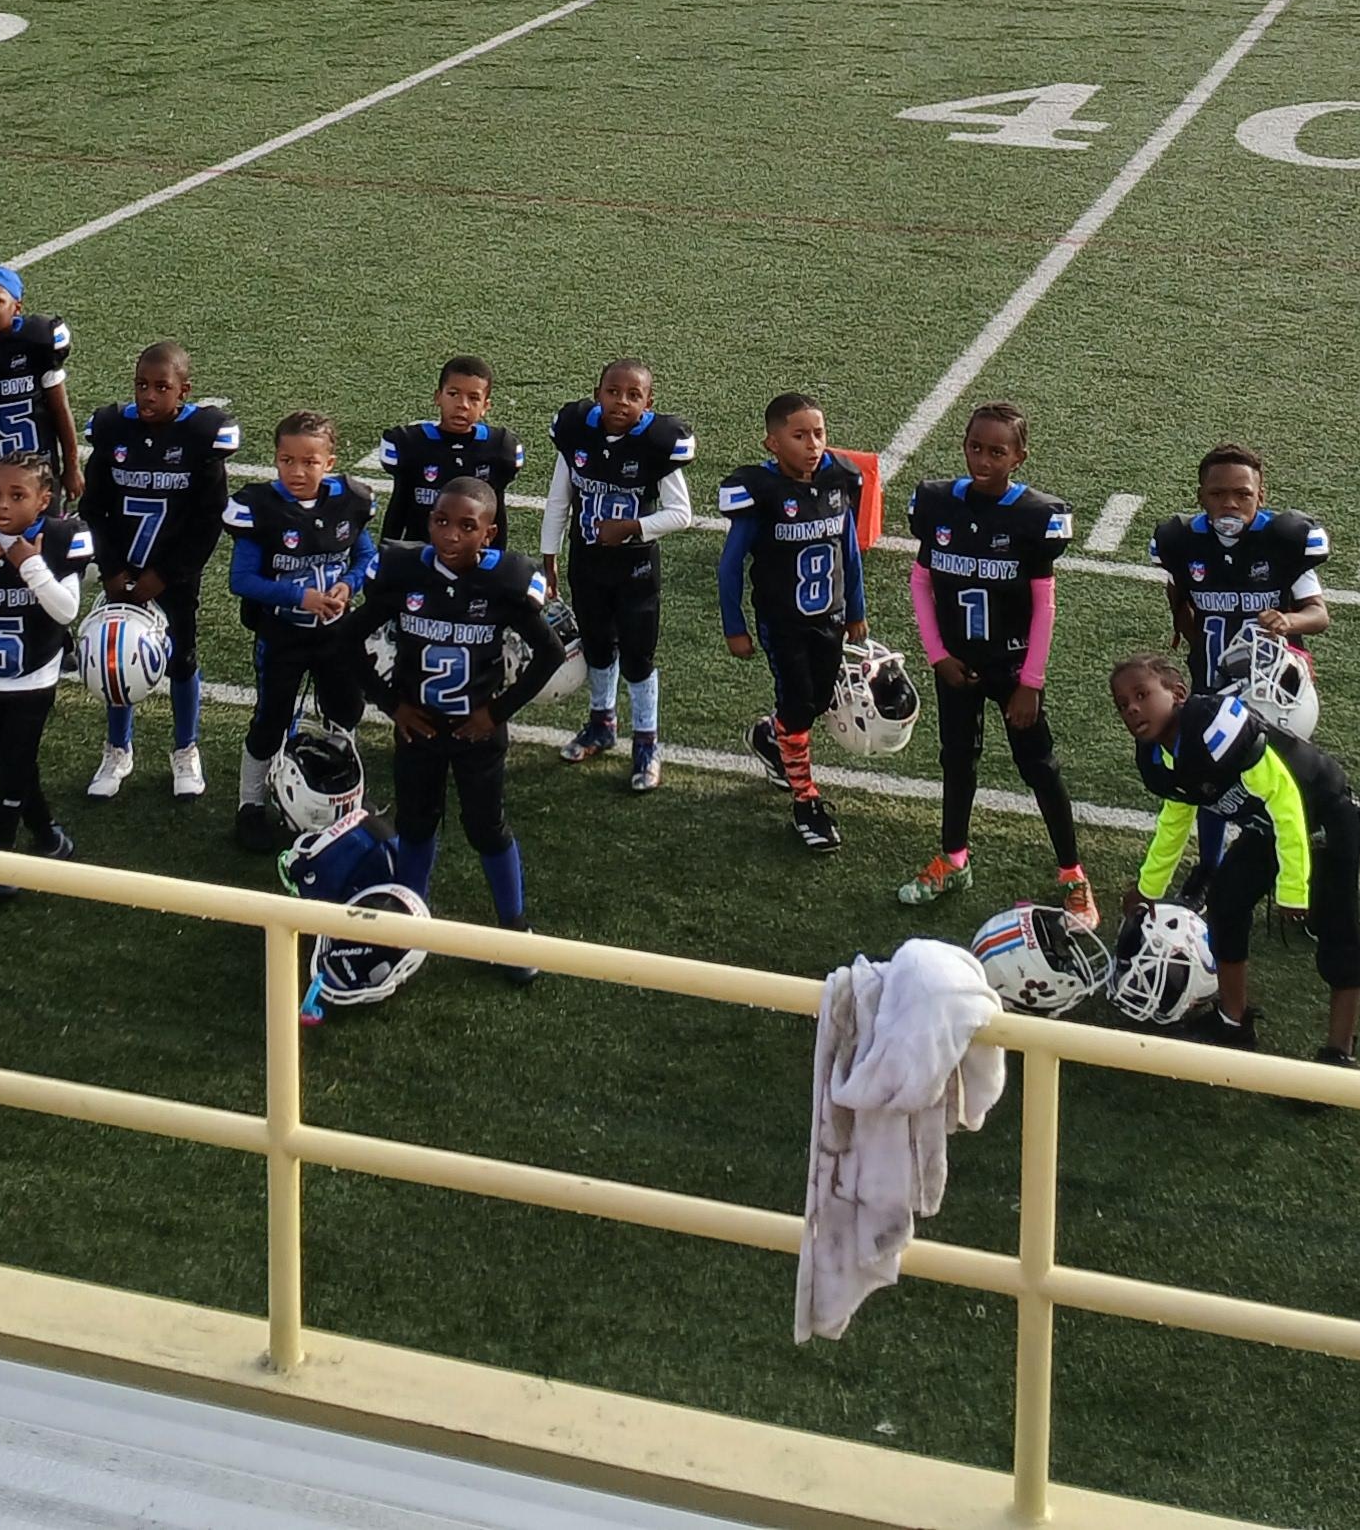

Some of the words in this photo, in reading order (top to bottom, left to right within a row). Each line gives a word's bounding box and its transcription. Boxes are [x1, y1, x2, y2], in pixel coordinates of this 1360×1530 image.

[122, 495, 168, 569] 7
[774, 519, 826, 541] CHOMP
[795, 543, 835, 617] 8
[930, 549, 977, 577] CHOMP
[977, 557, 1020, 580] BOYZ
[400, 612, 453, 643] CHOMP
[453, 622, 497, 643] BOYZ
[957, 588, 990, 641] 1
[420, 643, 471, 716] 2
